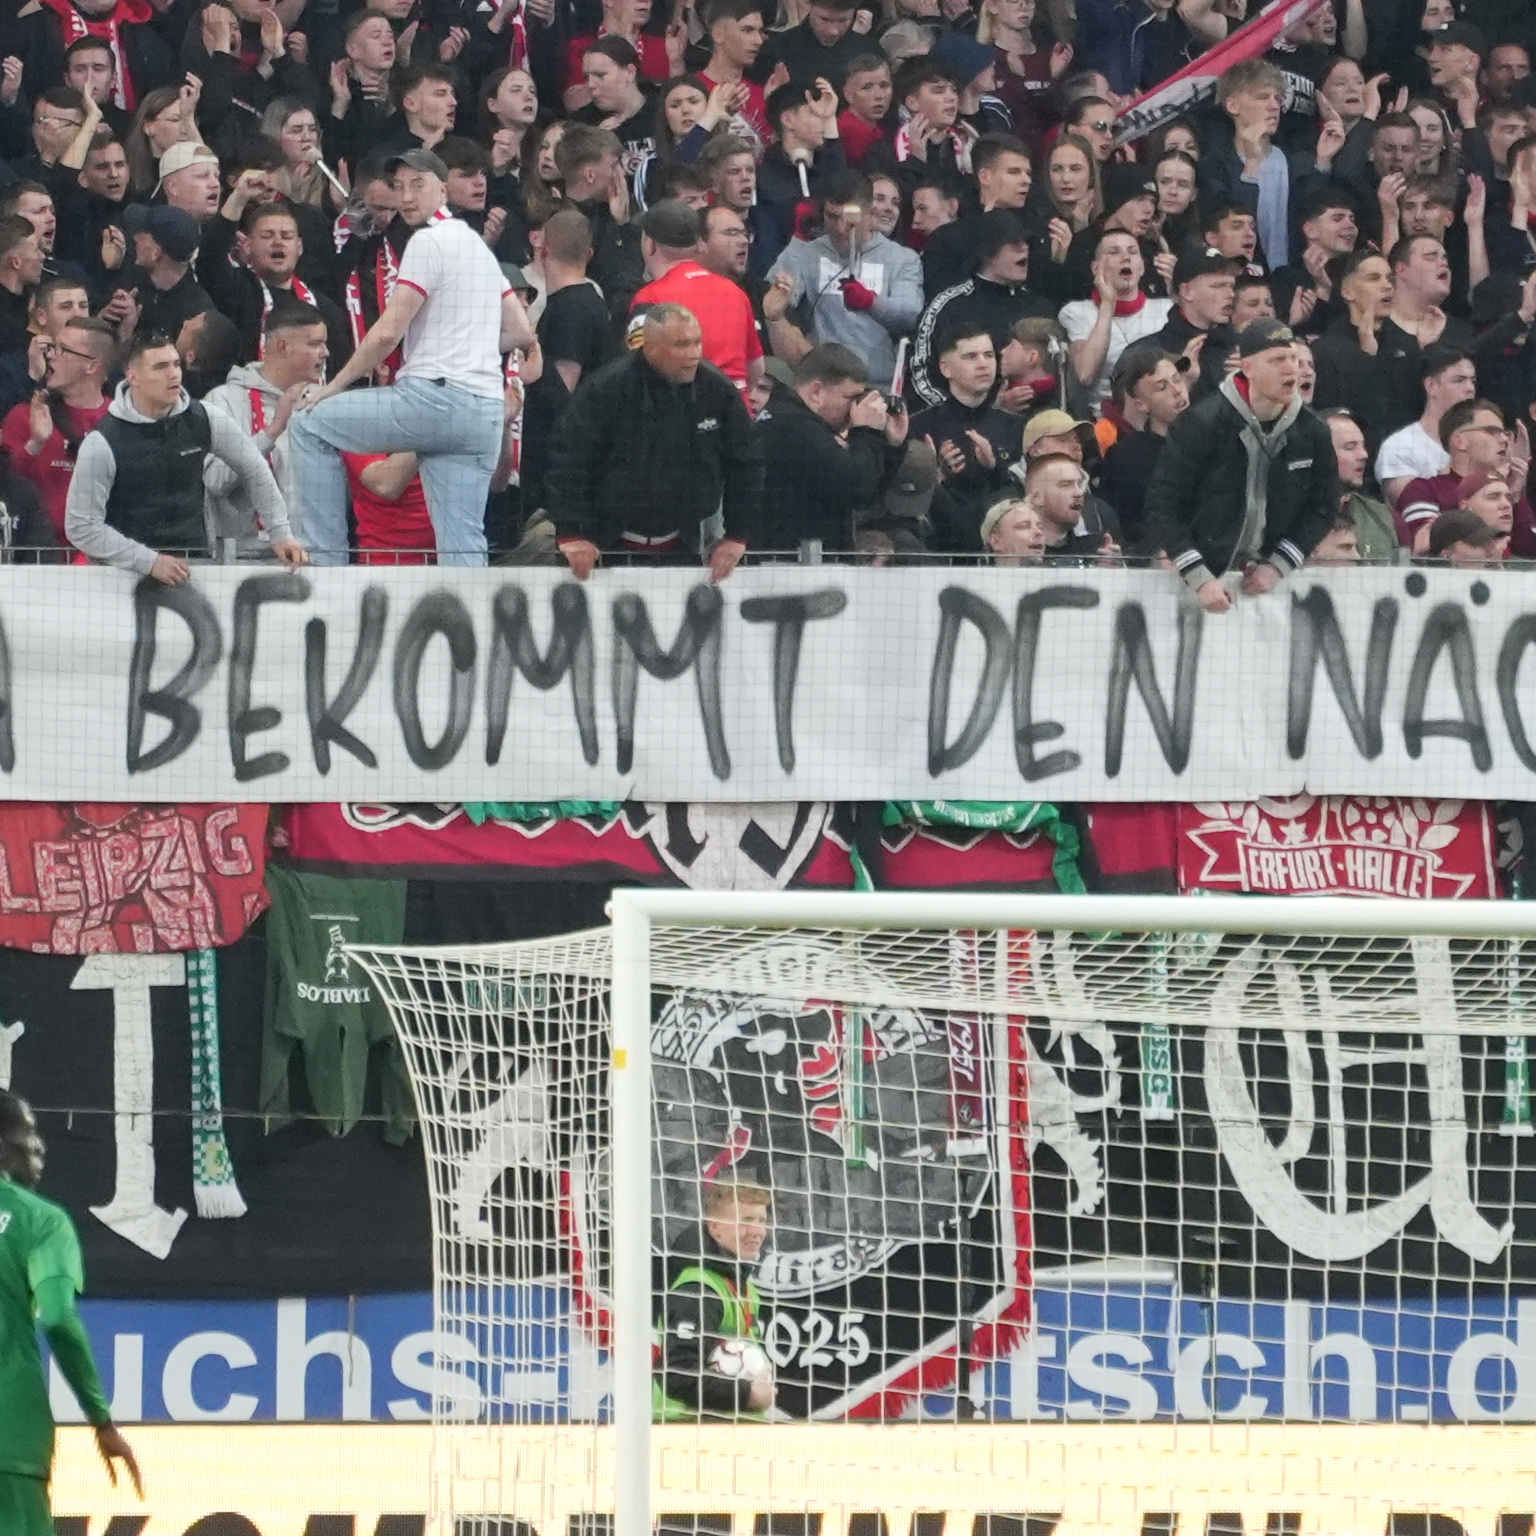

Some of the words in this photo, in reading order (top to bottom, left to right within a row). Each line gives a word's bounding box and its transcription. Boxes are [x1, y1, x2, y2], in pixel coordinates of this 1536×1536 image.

[125, 572, 850, 784] BEKOMMT
[926, 584, 1207, 782] DEN
[757, 1311, 870, 1369] 025
